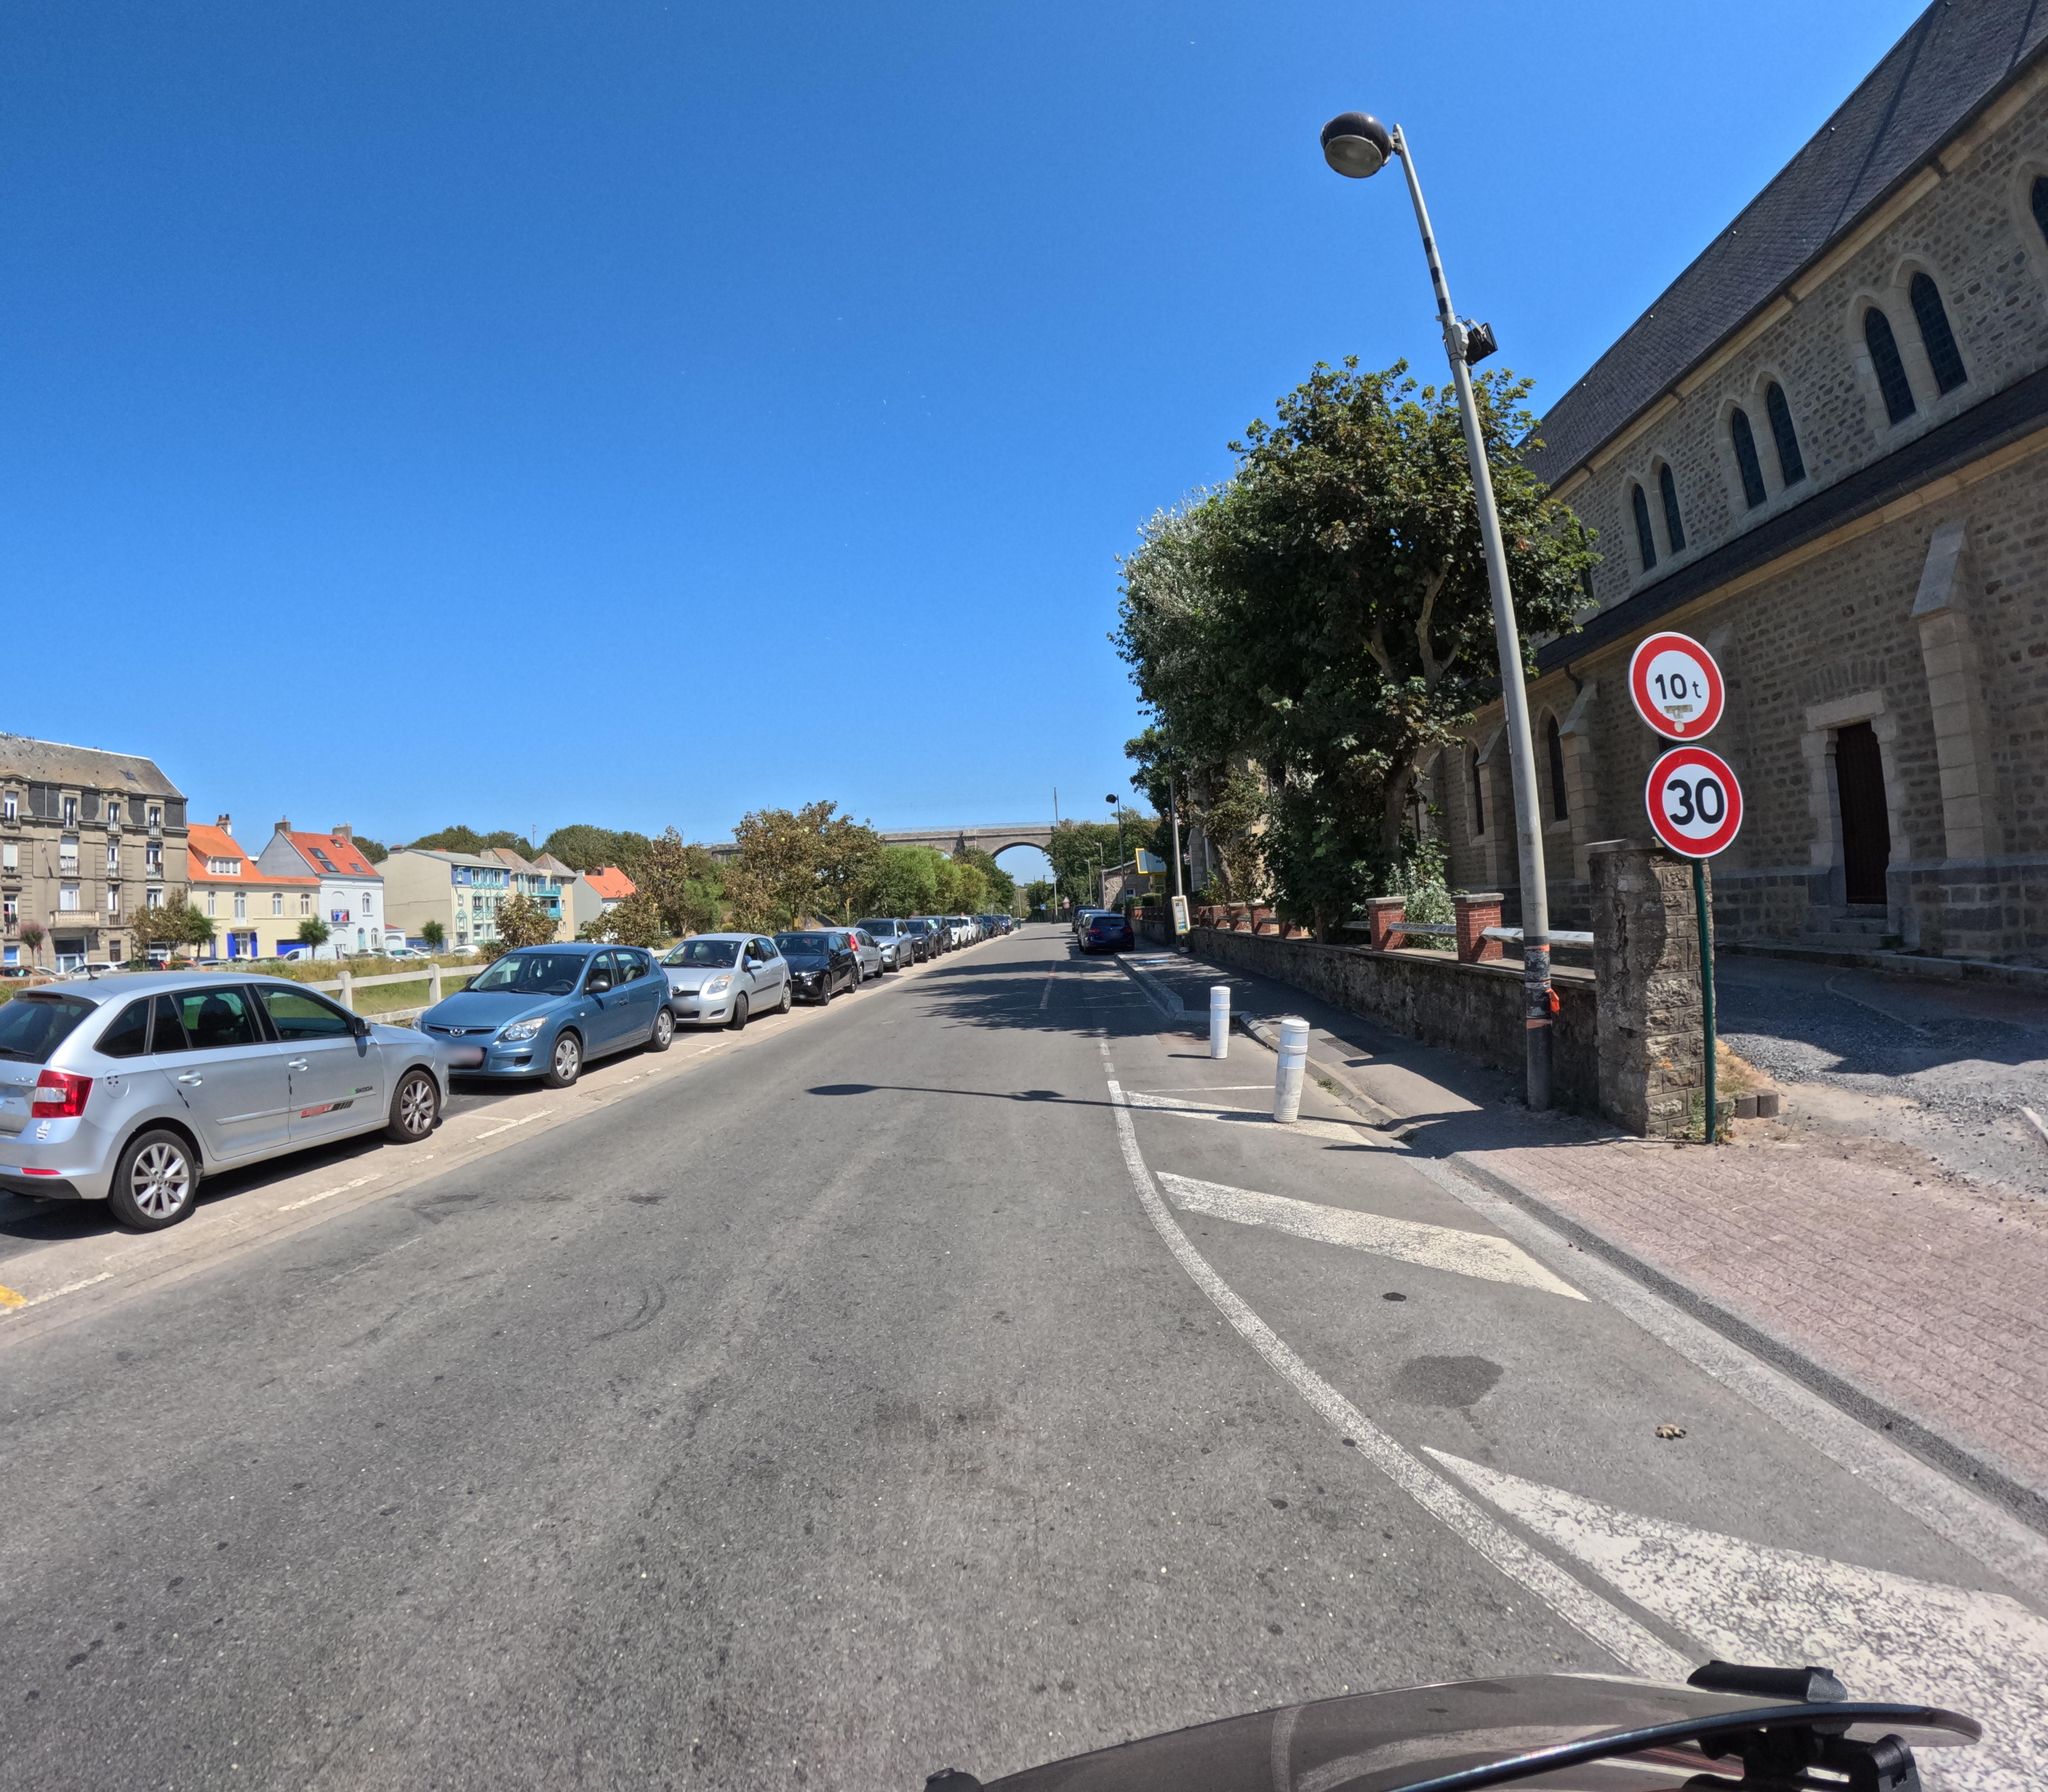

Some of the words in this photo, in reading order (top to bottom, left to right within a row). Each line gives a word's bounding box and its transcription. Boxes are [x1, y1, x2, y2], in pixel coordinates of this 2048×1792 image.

[1655, 673, 1687, 700] 10
[1692, 680, 1702, 699] t
[1666, 777, 1725, 825] 30
